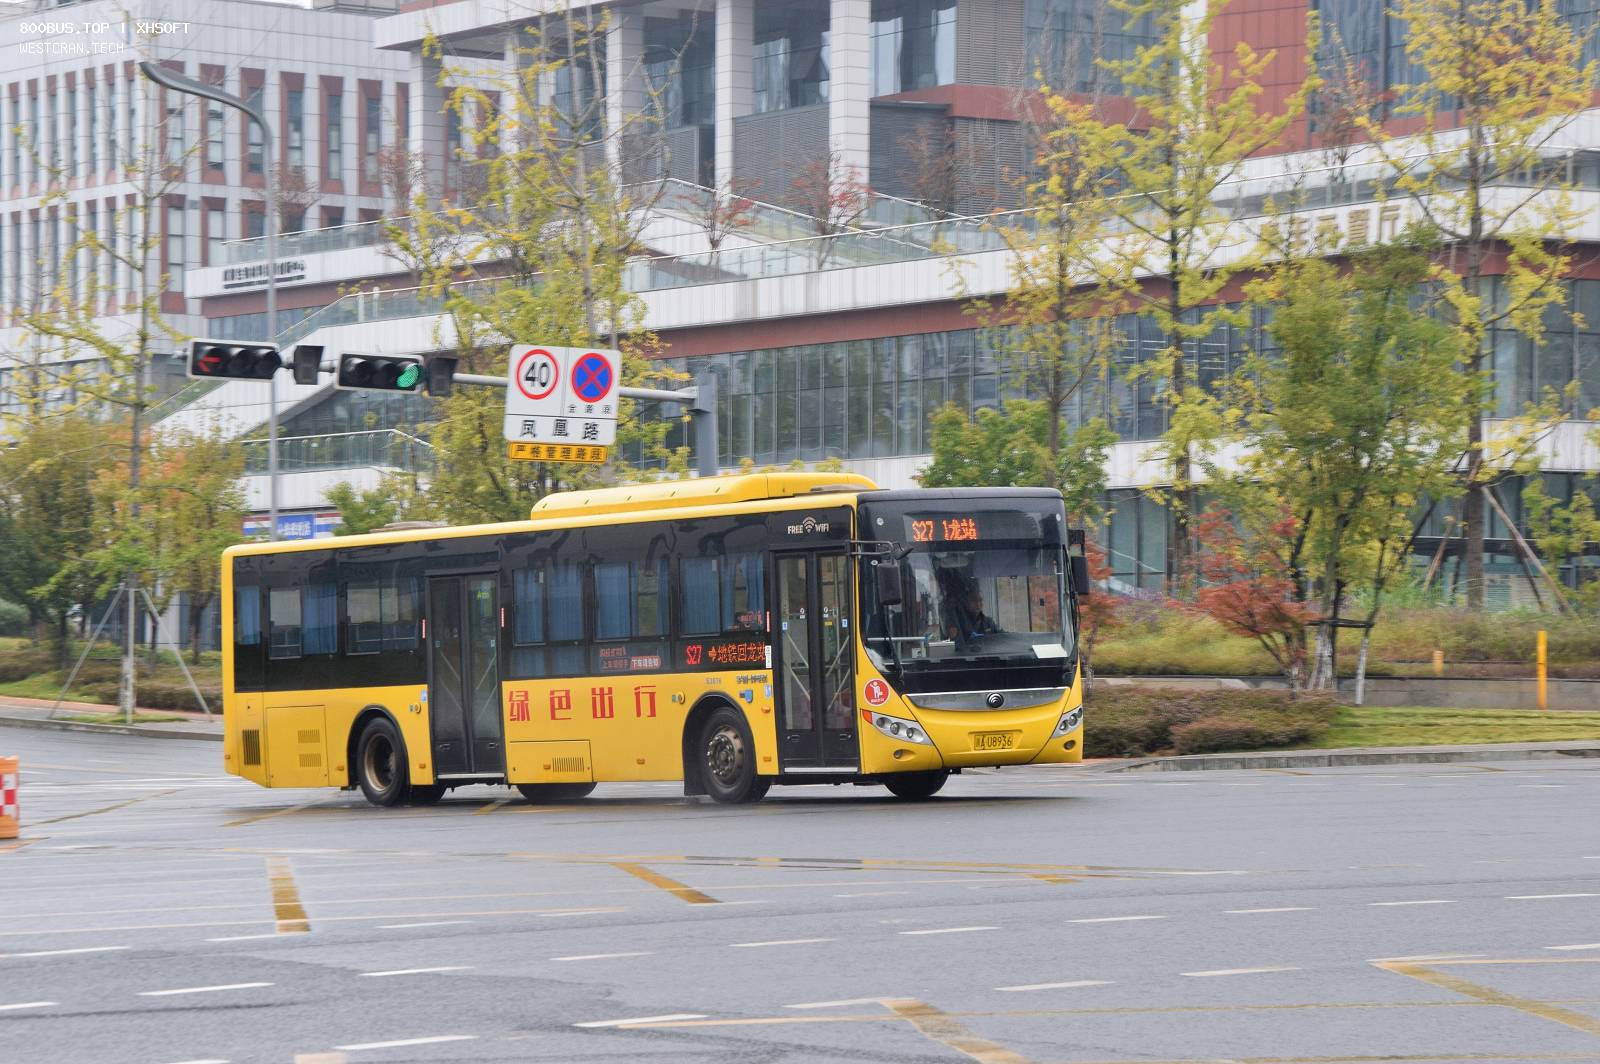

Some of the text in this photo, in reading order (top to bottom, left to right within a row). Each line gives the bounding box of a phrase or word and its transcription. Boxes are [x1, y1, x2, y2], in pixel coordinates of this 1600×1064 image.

[525, 362, 550, 388] 40
[520, 419, 599, 440] 凤凰路
[787, 525, 804, 535] FREE
[912, 520, 933, 542] S27
[687, 645, 703, 665] S27
[508, 685, 657, 722] 绿色出行
